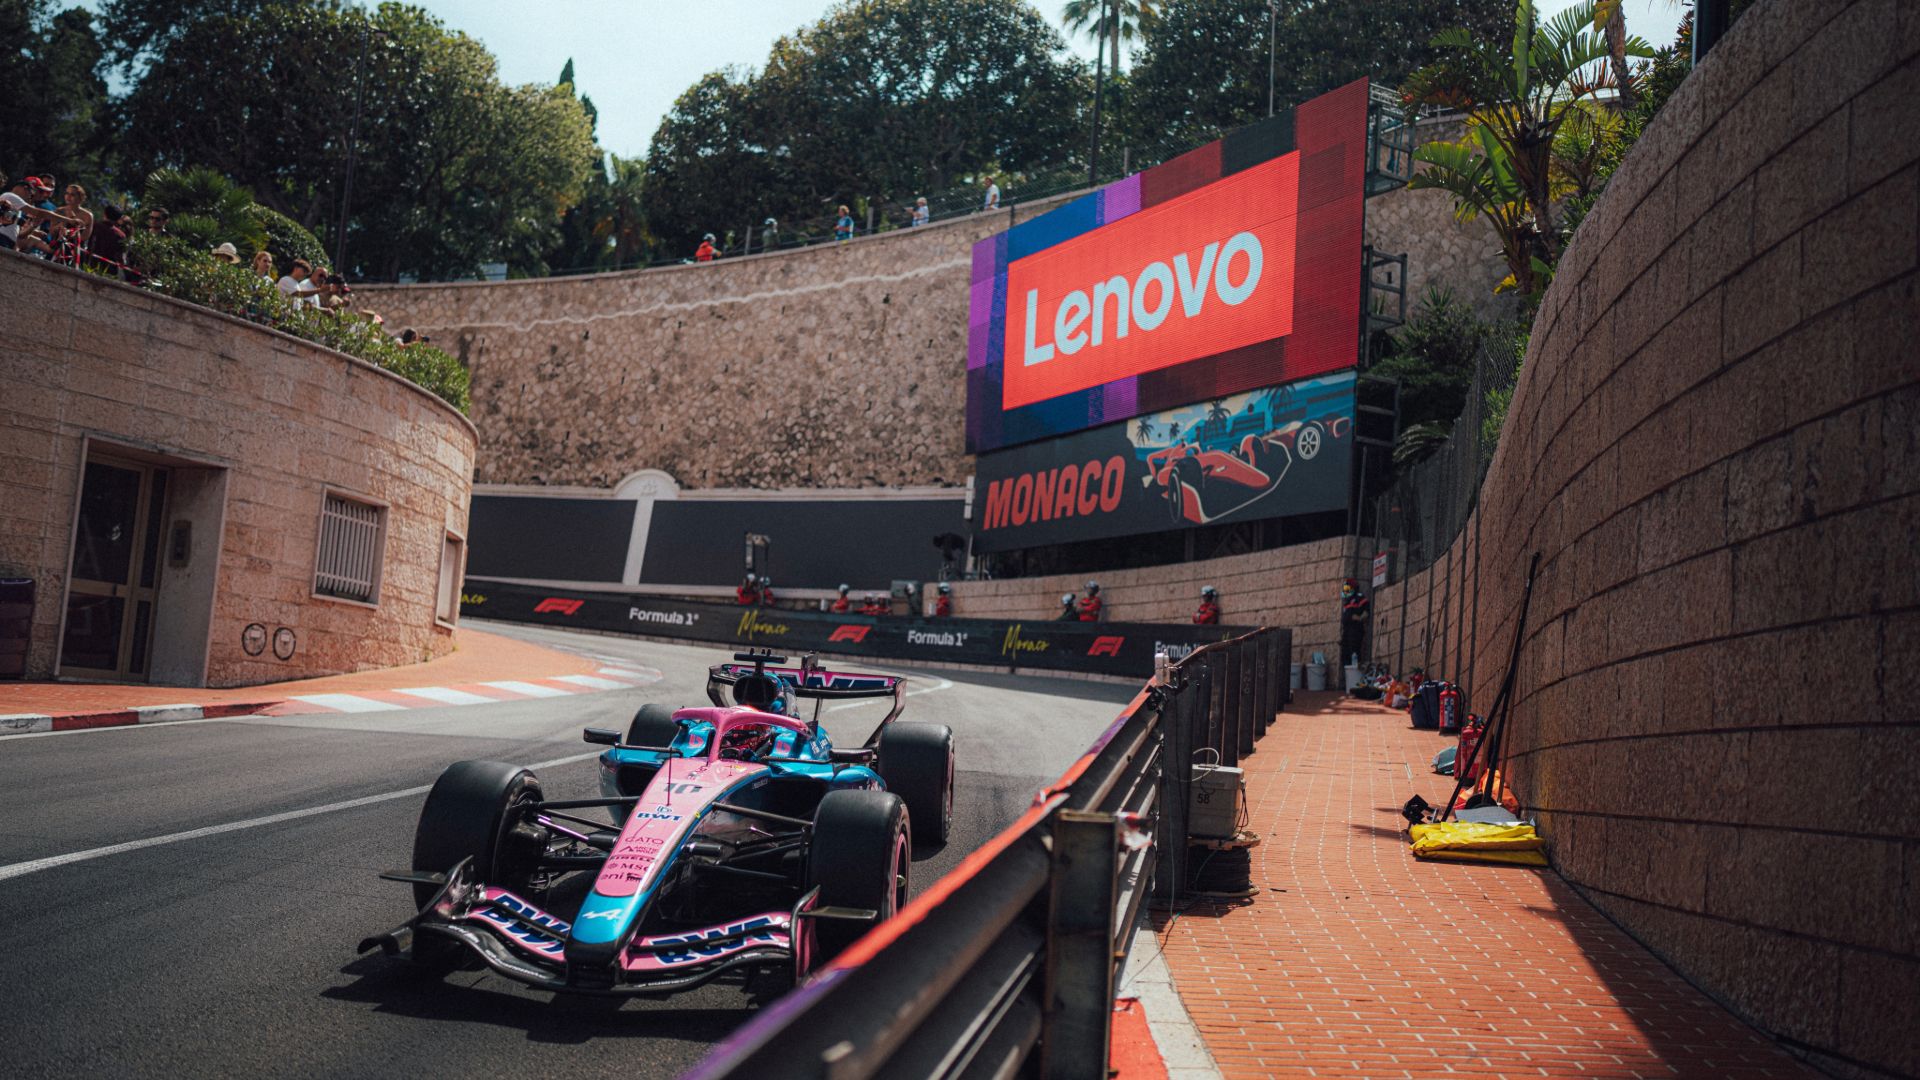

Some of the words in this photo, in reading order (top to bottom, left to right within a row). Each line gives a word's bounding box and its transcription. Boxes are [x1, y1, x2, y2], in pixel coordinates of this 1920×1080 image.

[1023, 231, 1264, 367] Lenovo
[983, 455, 1126, 530] MONACO
[534, 597, 585, 616] F1
[629, 607, 684, 625] Formula
[737, 610, 790, 640] Monaco
[828, 624, 872, 643] F1
[907, 630, 954, 646] Formula
[1002, 624, 1050, 660] Monaco
[1087, 635, 1126, 657] F1
[637, 812, 683, 821] BWT
[601, 872, 625, 880] eni
[620, 863, 649, 872] MSC
